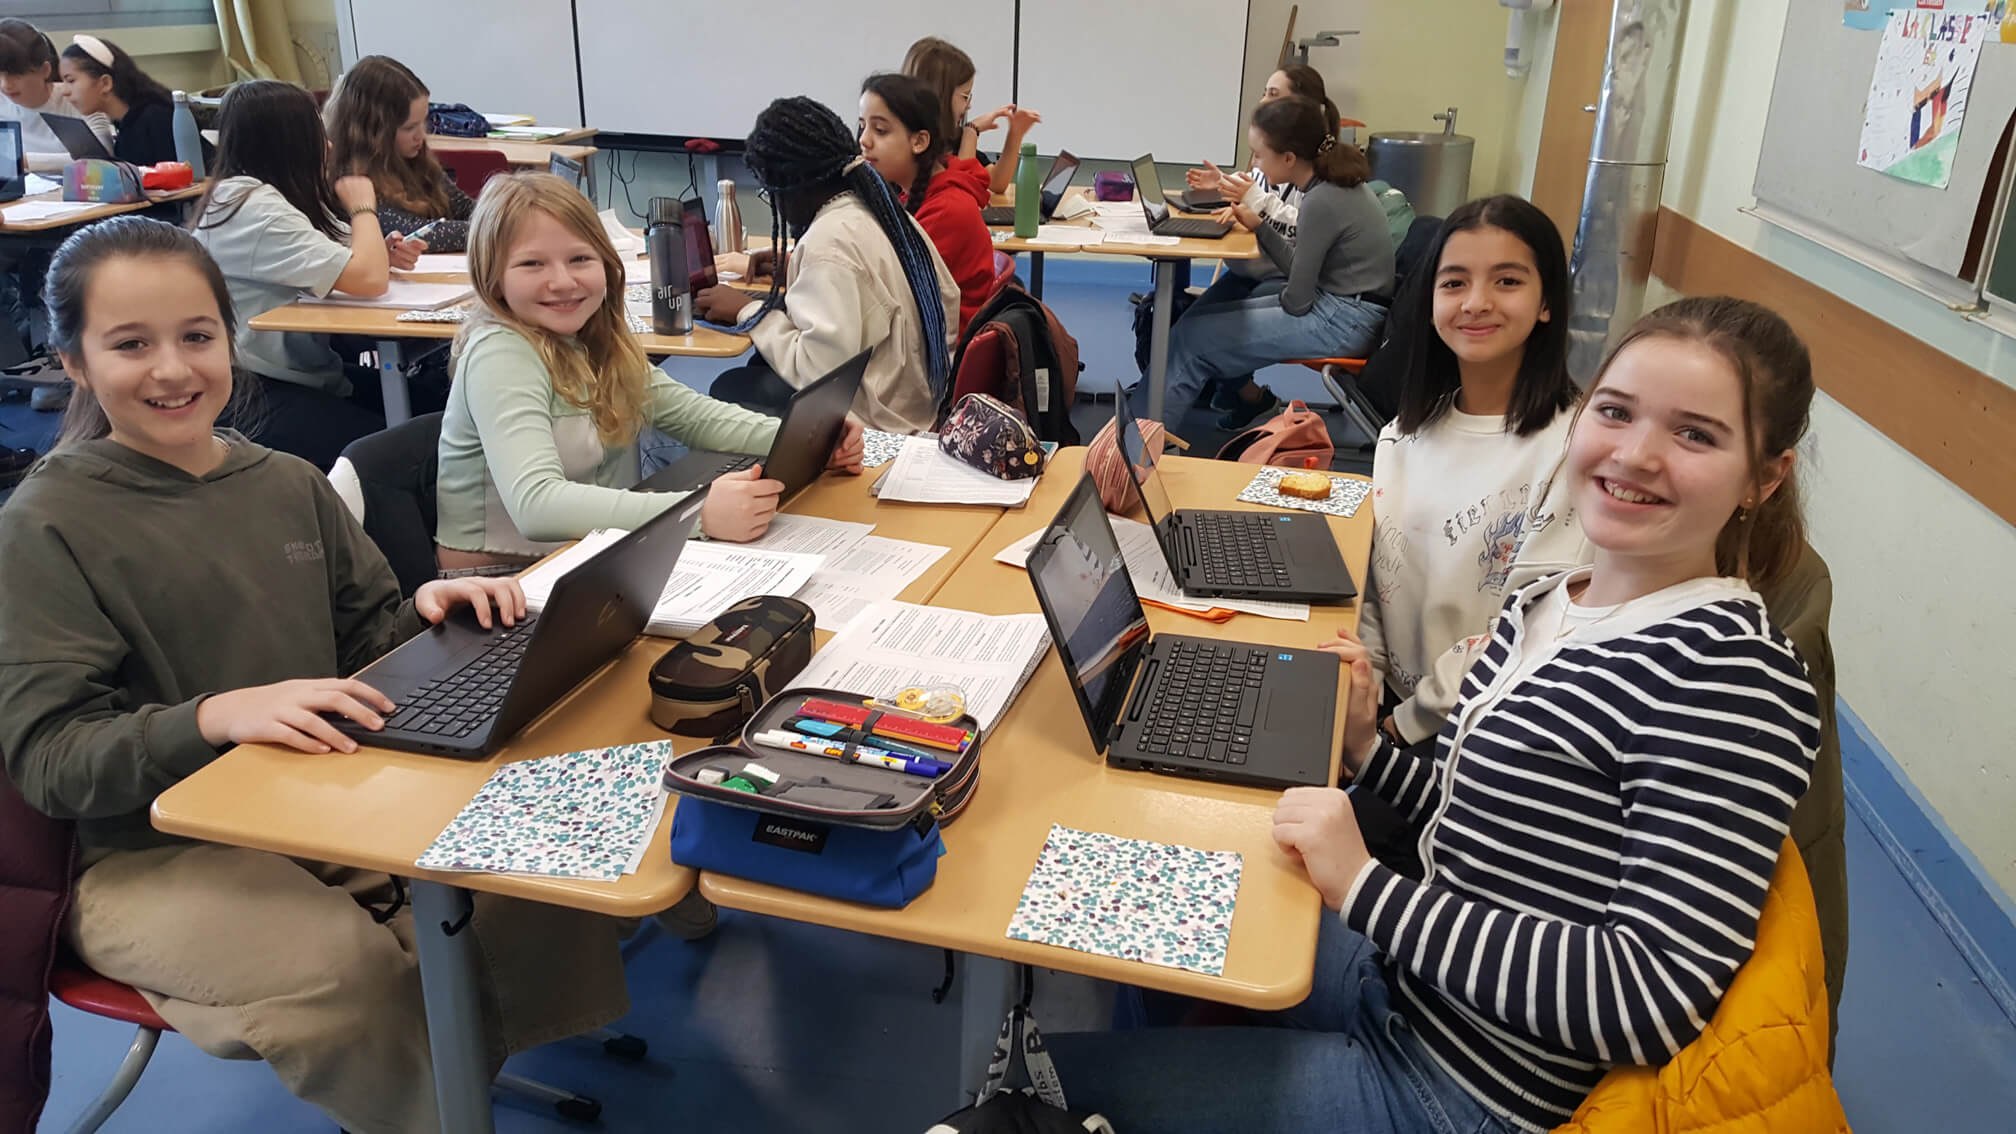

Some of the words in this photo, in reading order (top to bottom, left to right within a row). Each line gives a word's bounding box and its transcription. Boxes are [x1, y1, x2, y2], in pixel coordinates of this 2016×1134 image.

[658, 285, 673, 300] air
[669, 296, 682, 311] up
[766, 824, 817, 842] EASTPAK
